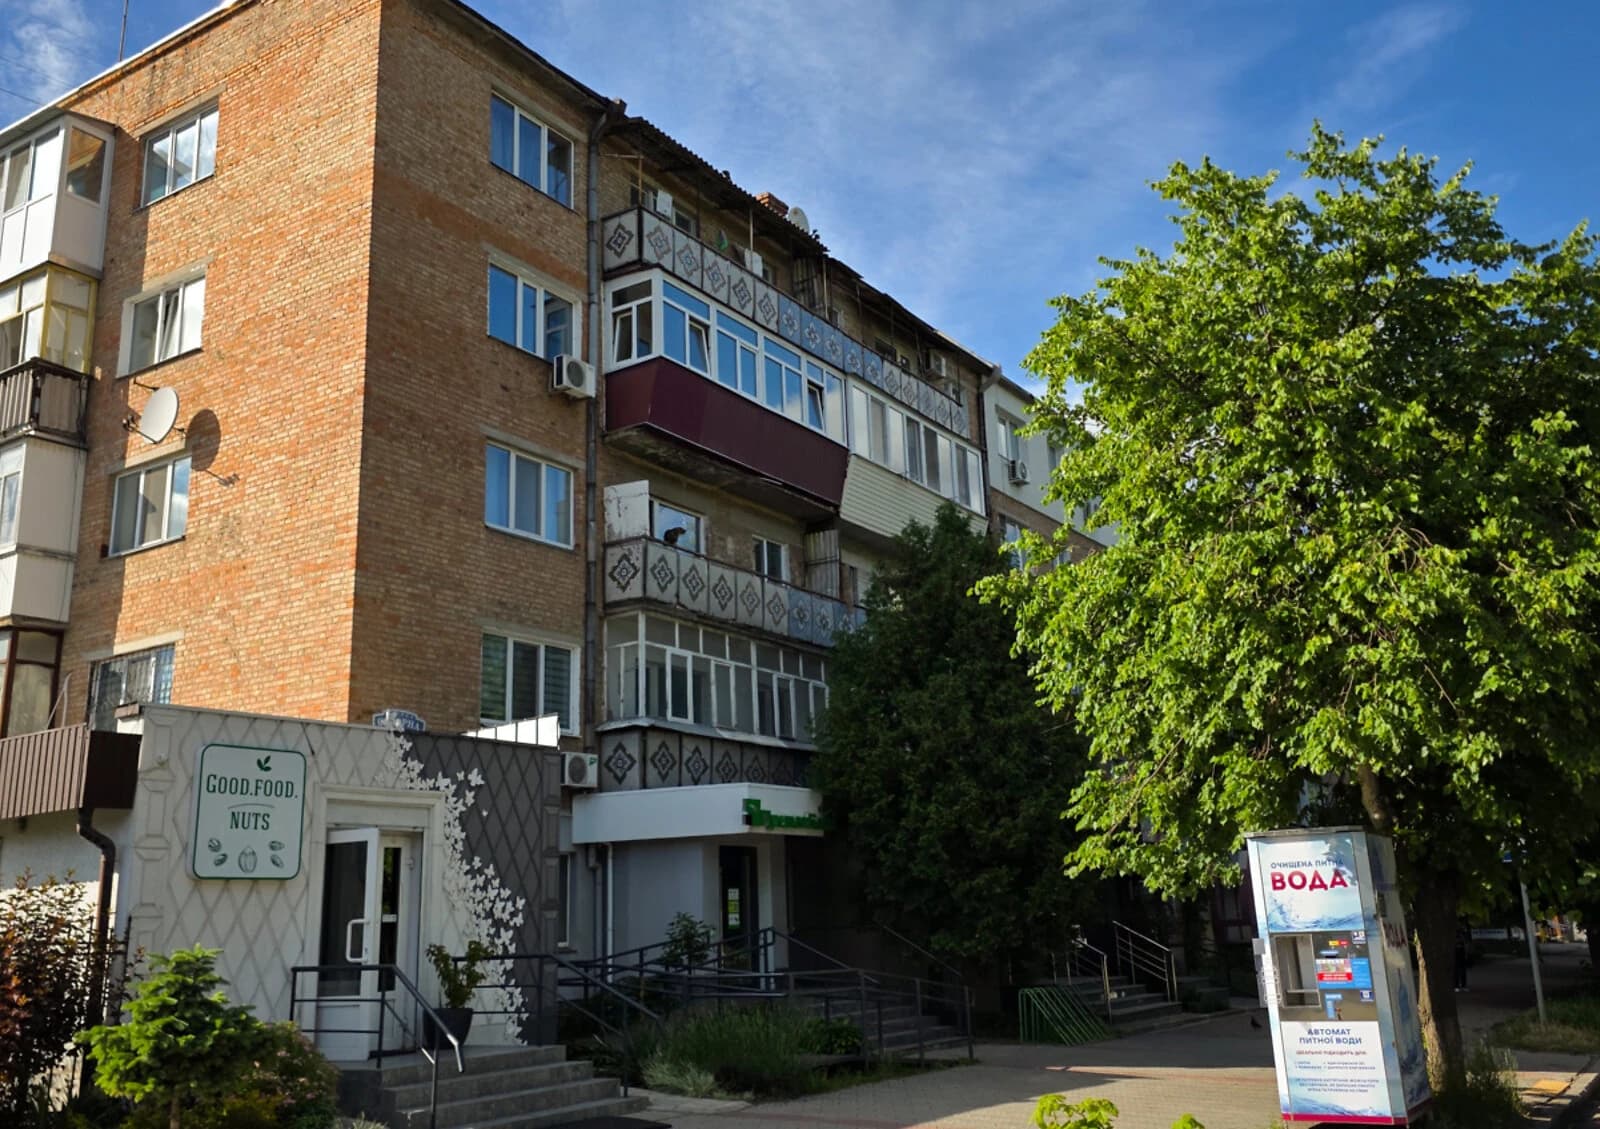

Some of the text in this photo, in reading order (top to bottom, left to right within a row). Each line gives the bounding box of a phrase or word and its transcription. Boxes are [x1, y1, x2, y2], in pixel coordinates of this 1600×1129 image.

[229, 811, 271, 830] NUTS
[1270, 861, 1313, 869] ОЧИЩЕНА
[1270, 869, 1349, 891] ВОДА
[1307, 1028, 1351, 1036] АВТОМАТ
[1299, 1036, 1362, 1045] ПИТНОЇ ВОДИ
